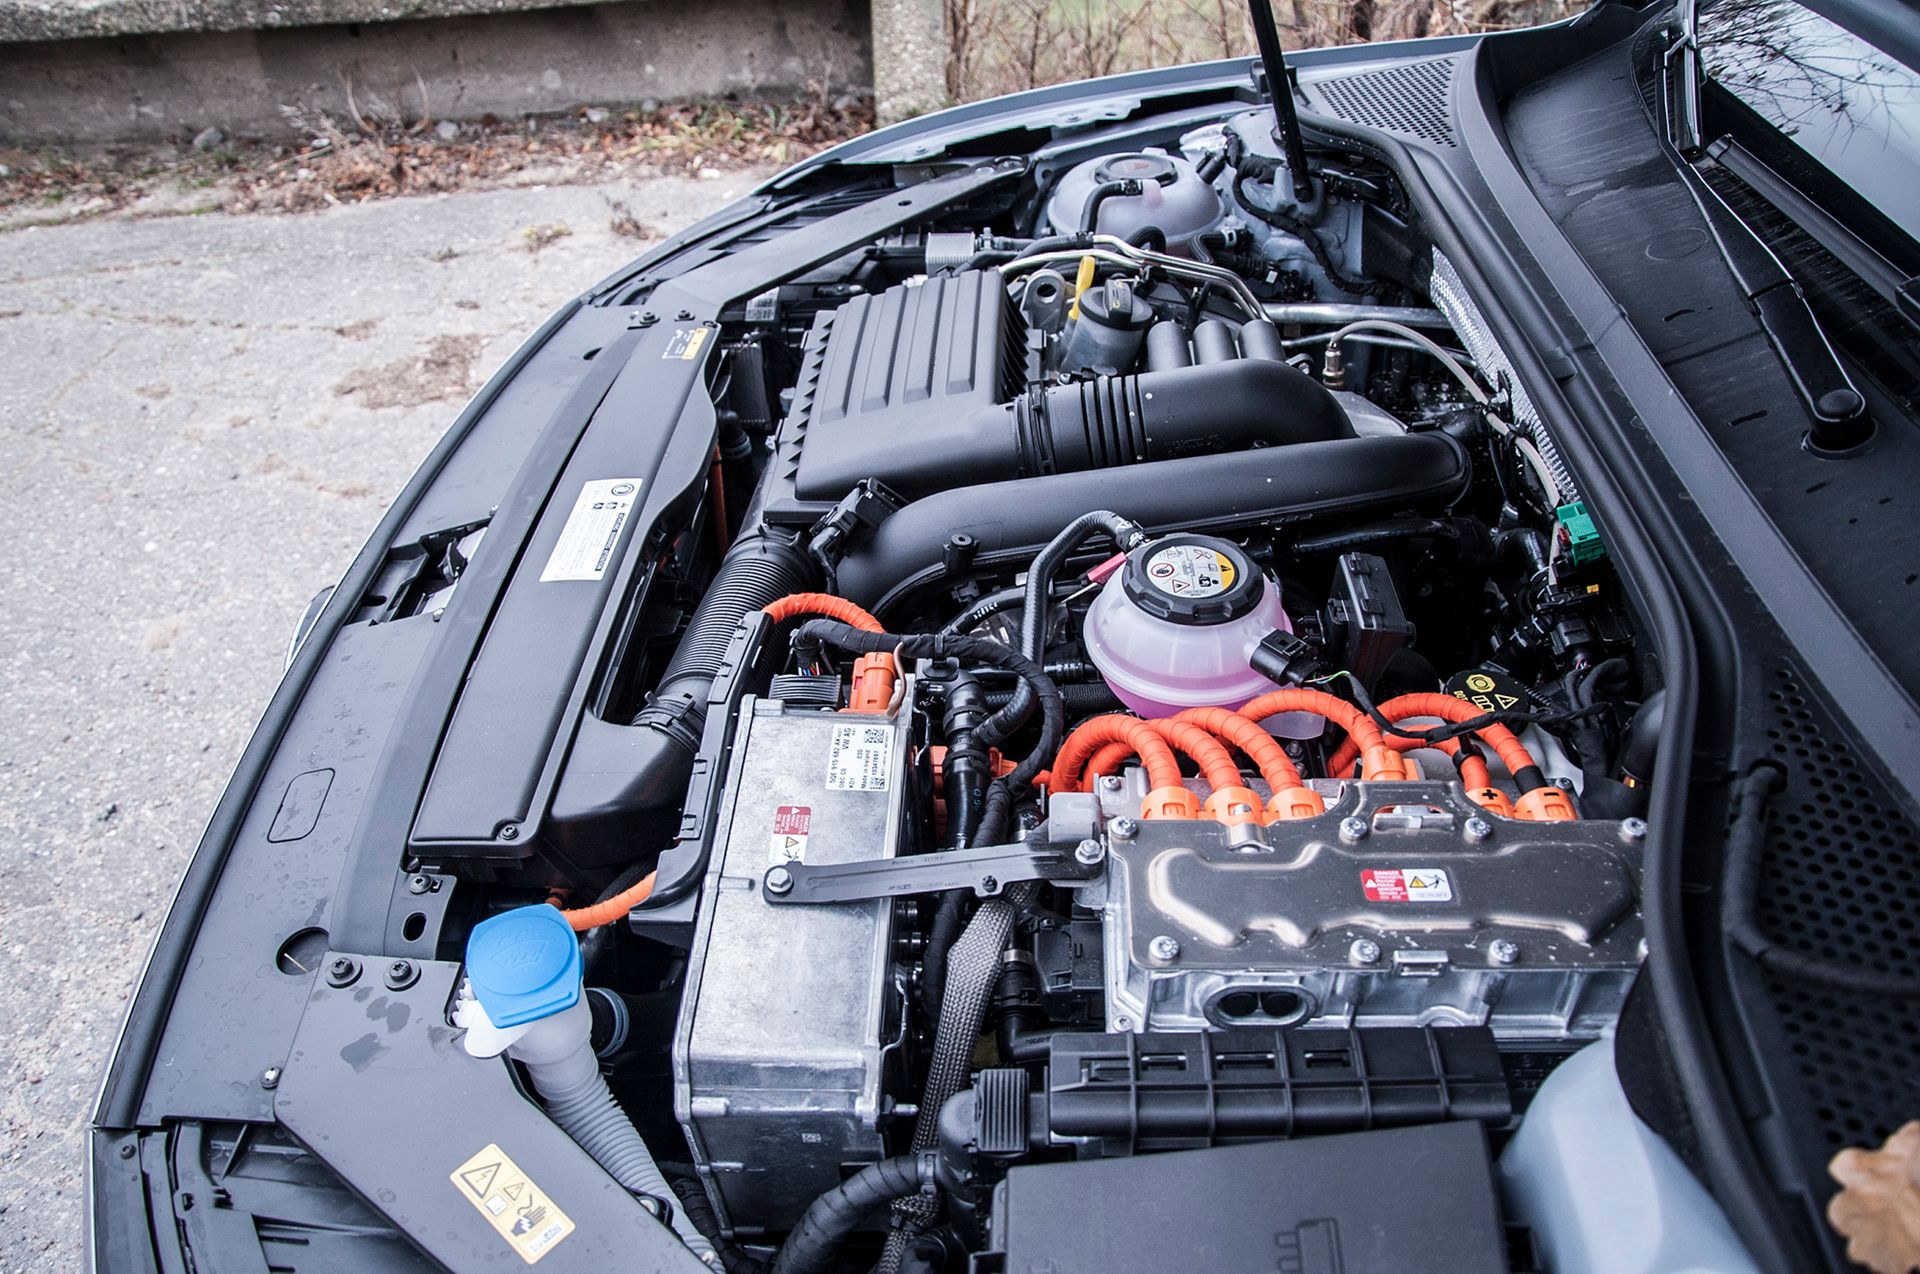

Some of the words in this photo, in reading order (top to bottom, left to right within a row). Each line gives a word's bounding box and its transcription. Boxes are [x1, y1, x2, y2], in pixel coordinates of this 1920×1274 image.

[844, 727, 852, 737] AG
[842, 738, 850, 750] VW
[831, 759, 839, 770] 915
